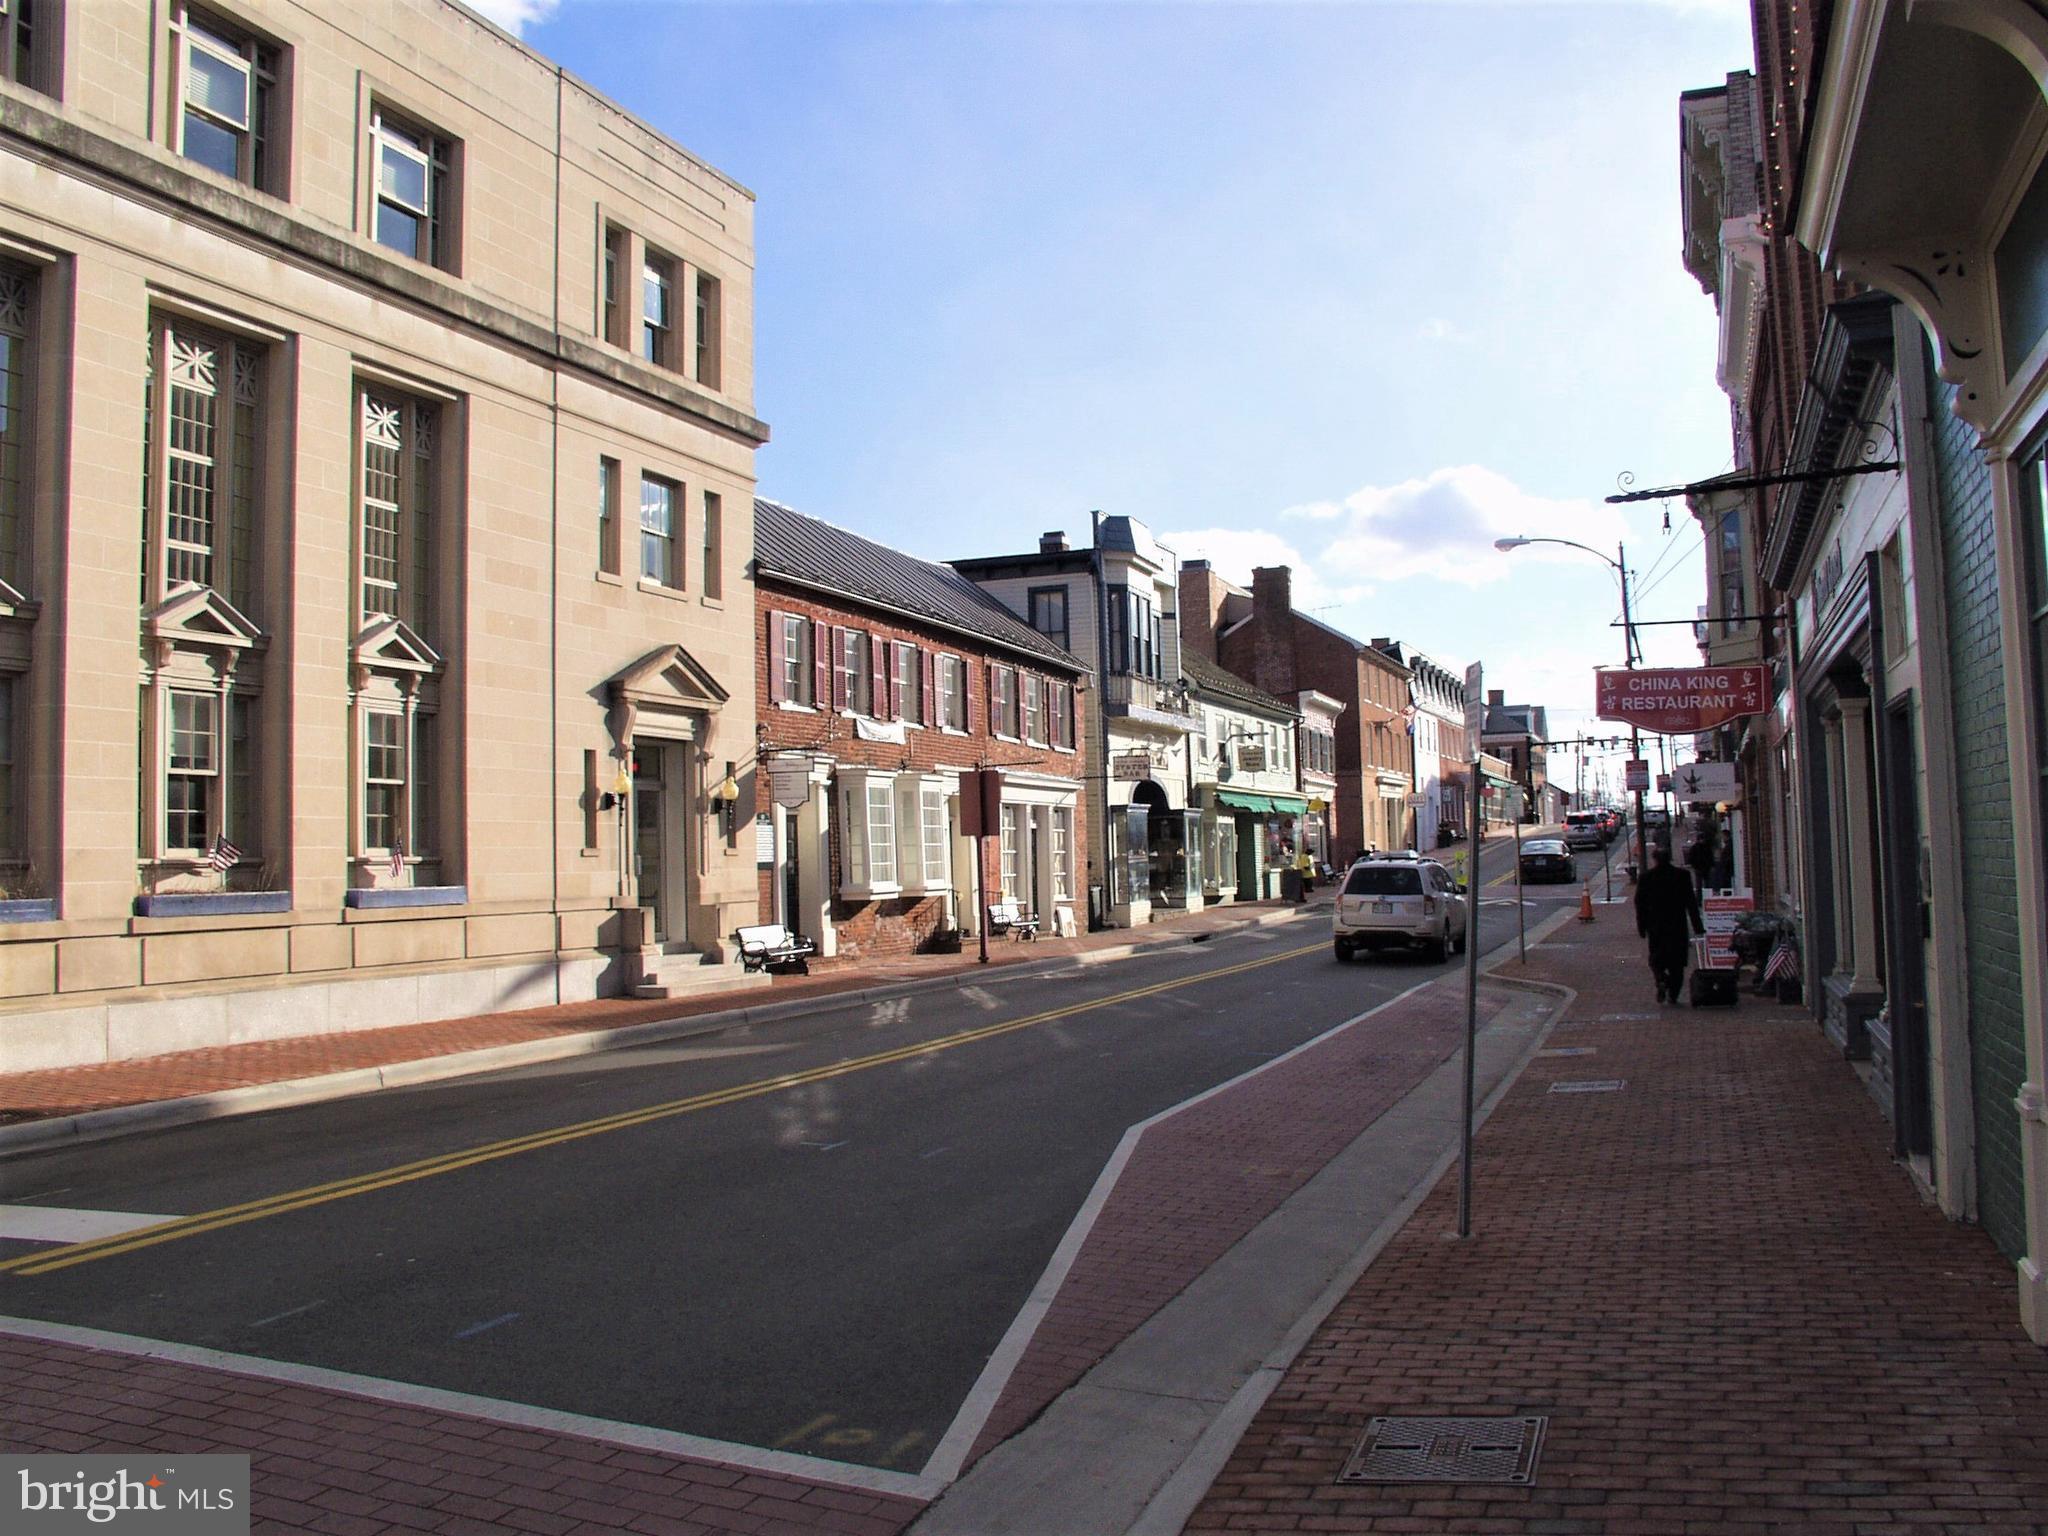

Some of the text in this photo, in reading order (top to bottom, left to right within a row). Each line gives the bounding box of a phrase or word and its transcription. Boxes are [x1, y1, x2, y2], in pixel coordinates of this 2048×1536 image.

[1628, 676, 1681, 691] CHINA
[1686, 675, 1729, 689] KING
[1621, 694, 1737, 710] RESTAURANT
